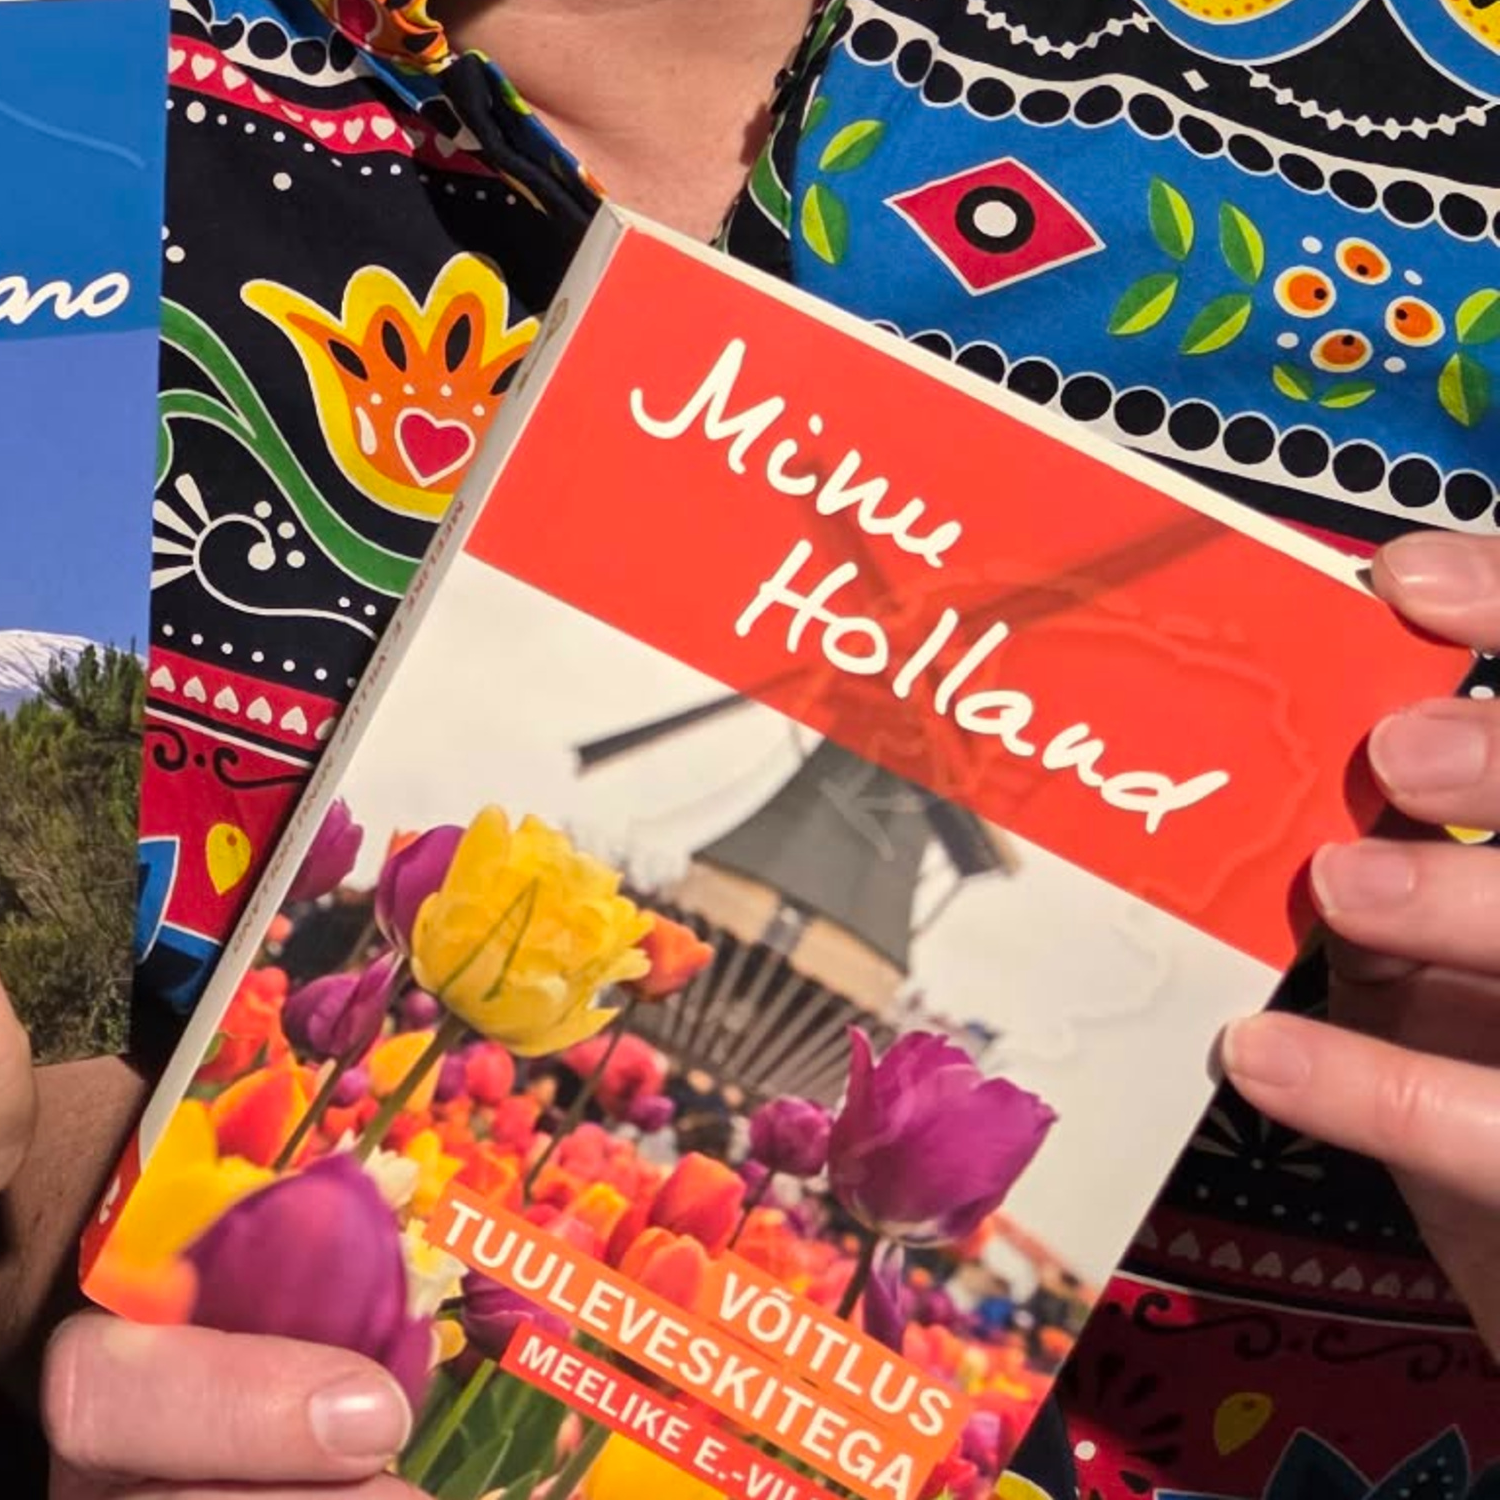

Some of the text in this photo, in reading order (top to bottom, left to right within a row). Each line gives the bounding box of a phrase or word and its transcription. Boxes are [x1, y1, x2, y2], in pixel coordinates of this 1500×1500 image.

[628, 338, 964, 568] Minu
[734, 540, 1231, 834] Holland
[441, 1199, 914, 1500] TUULEVESKITEGA
[517, 1335, 692, 1454] MEELIKE
[717, 1272, 953, 1438] VÕITLUS
